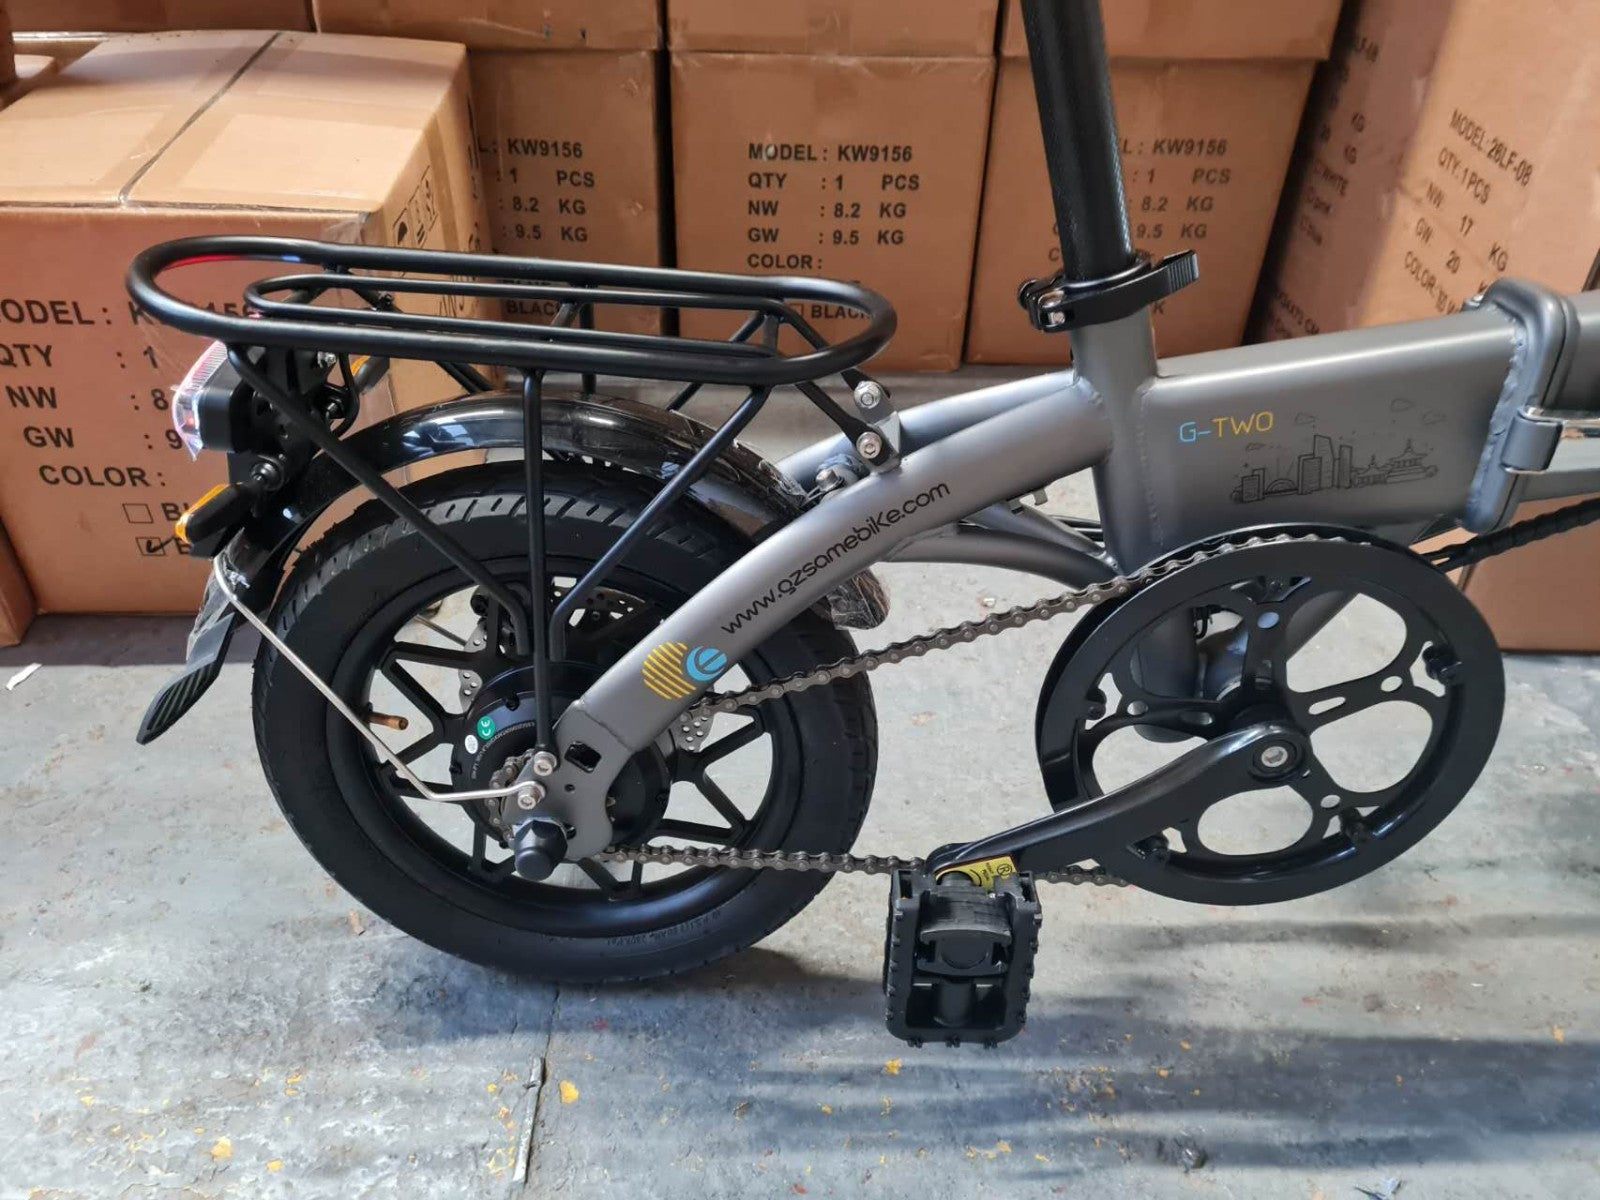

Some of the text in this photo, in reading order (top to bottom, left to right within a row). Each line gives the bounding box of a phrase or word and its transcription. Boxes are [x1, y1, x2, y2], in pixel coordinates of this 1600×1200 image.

[507, 138, 583, 158] KW9156
[837, 145, 912, 163] KW9156
[1152, 139, 1228, 156] KW9156
[556, 170, 595, 188] PCS
[748, 172, 788, 189] QTY
[835, 175, 844, 190] 1
[881, 175, 920, 191] PCS
[1191, 169, 1232, 184] PCS
[1466, 171, 1491, 204] PCS
[512, 197, 540, 212] 8.2
[558, 198, 586, 215] KG
[748, 200, 779, 216] NW
[834, 203, 861, 218] 8.2
[879, 203, 907, 218] KG
[1141, 197, 1214, 212] 8.2 KG
[515, 224, 542, 240] 9.5
[560, 226, 588, 242] KG
[747, 228, 779, 243] GW
[833, 230, 860, 245] 9.5
[877, 230, 905, 245] KG
[1136, 224, 1208, 239] 9.5 KG
[1460, 215, 1474, 237] 17
[1488, 242, 1509, 272] KG
[0, 299, 112, 325] ODEL:
[506, 300, 560, 316] BLAC
[811, 304, 871, 319] BLAC
[0, 344, 53, 368] QTY
[5, 385, 58, 409] NW
[1179, 411, 1274, 444] G-TWO
[23, 426, 75, 449] GW
